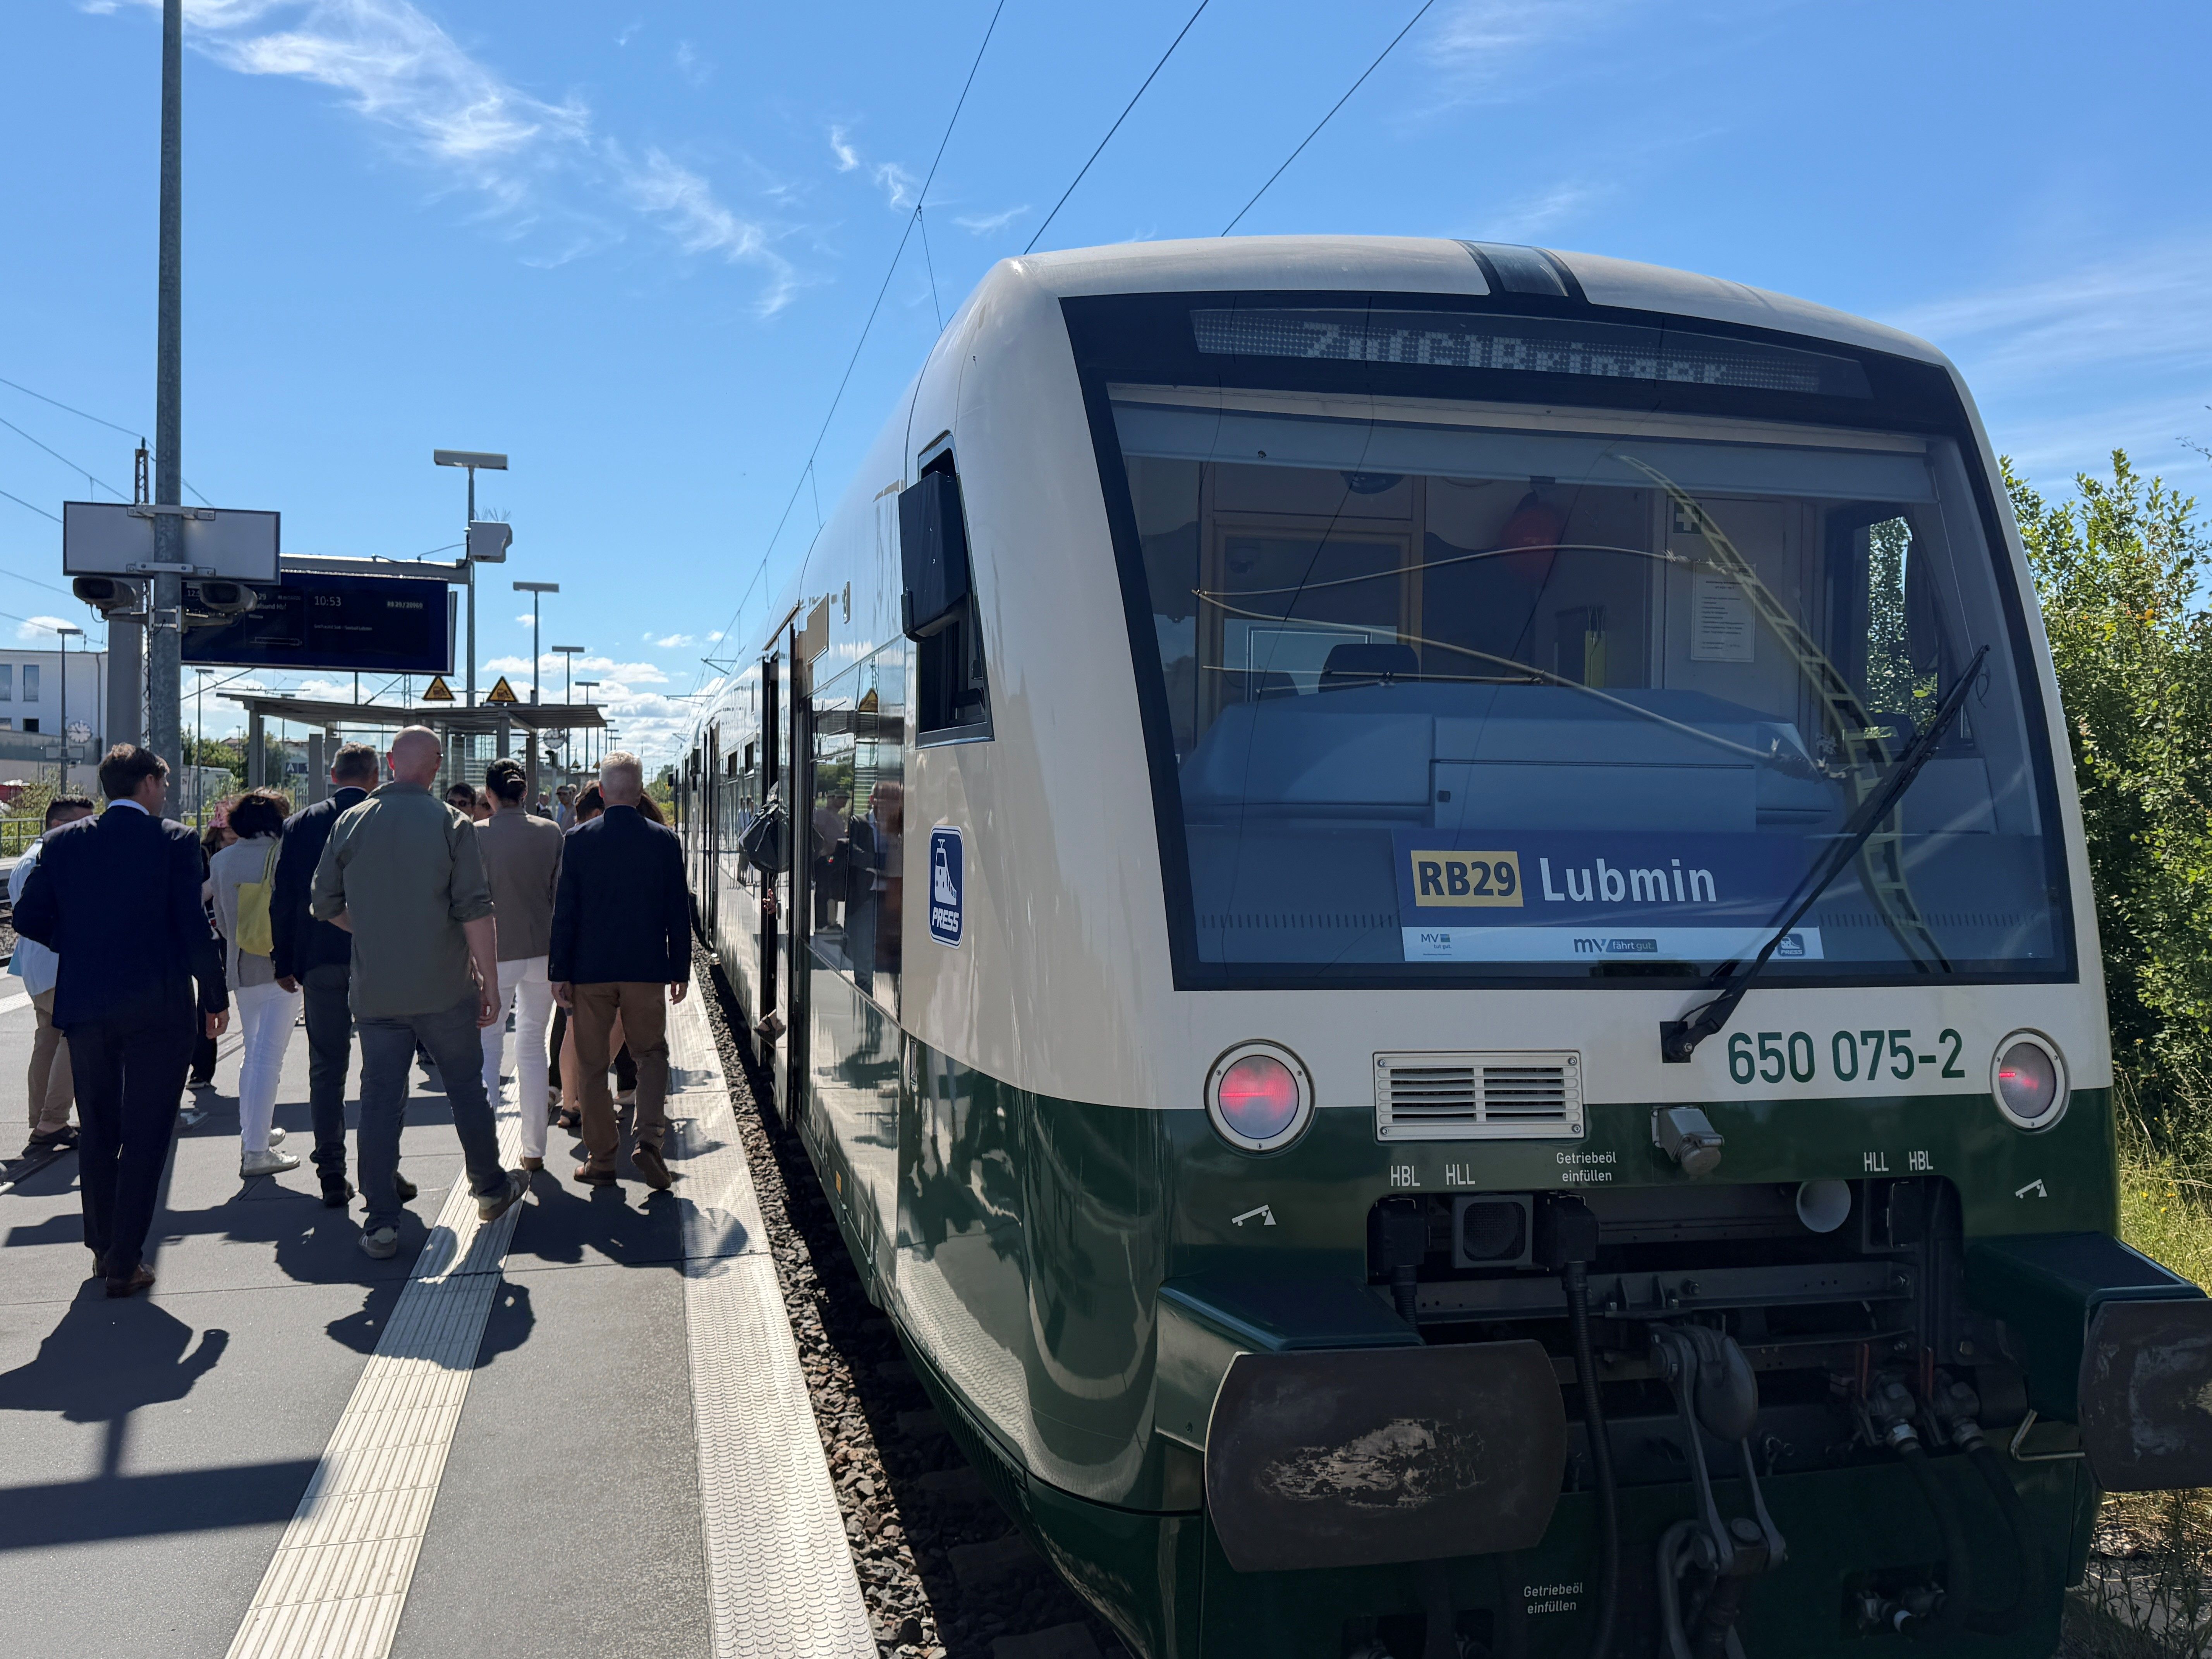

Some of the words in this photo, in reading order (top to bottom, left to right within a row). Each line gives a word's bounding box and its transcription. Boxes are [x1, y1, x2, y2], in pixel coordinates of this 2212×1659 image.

[314, 596, 342, 606] 10:53
[287, 763, 294, 772] A
[1418, 861, 1516, 896] RB29
[1540, 858, 1717, 902] Lubmin
[932, 907, 959, 933] PRESS
[1421, 934, 1439, 942] MV
[1613, 941, 1635, 950] fährt
[1728, 1031, 1815, 1084] 650
[1832, 1028, 1965, 1081] 075-2
[1556, 1152, 1616, 1165] Getriebeöl
[1863, 1152, 1889, 1172] HLL
[1909, 1151, 1933, 1170] HBL
[1391, 1165, 1420, 1187] HBL
[1445, 1164, 1475, 1185] HLL
[1562, 1170, 1612, 1182] einfüllen
[1524, 1582, 1583, 1597] Getriebeöl
[1527, 1600, 1576, 1614] einfüllen
